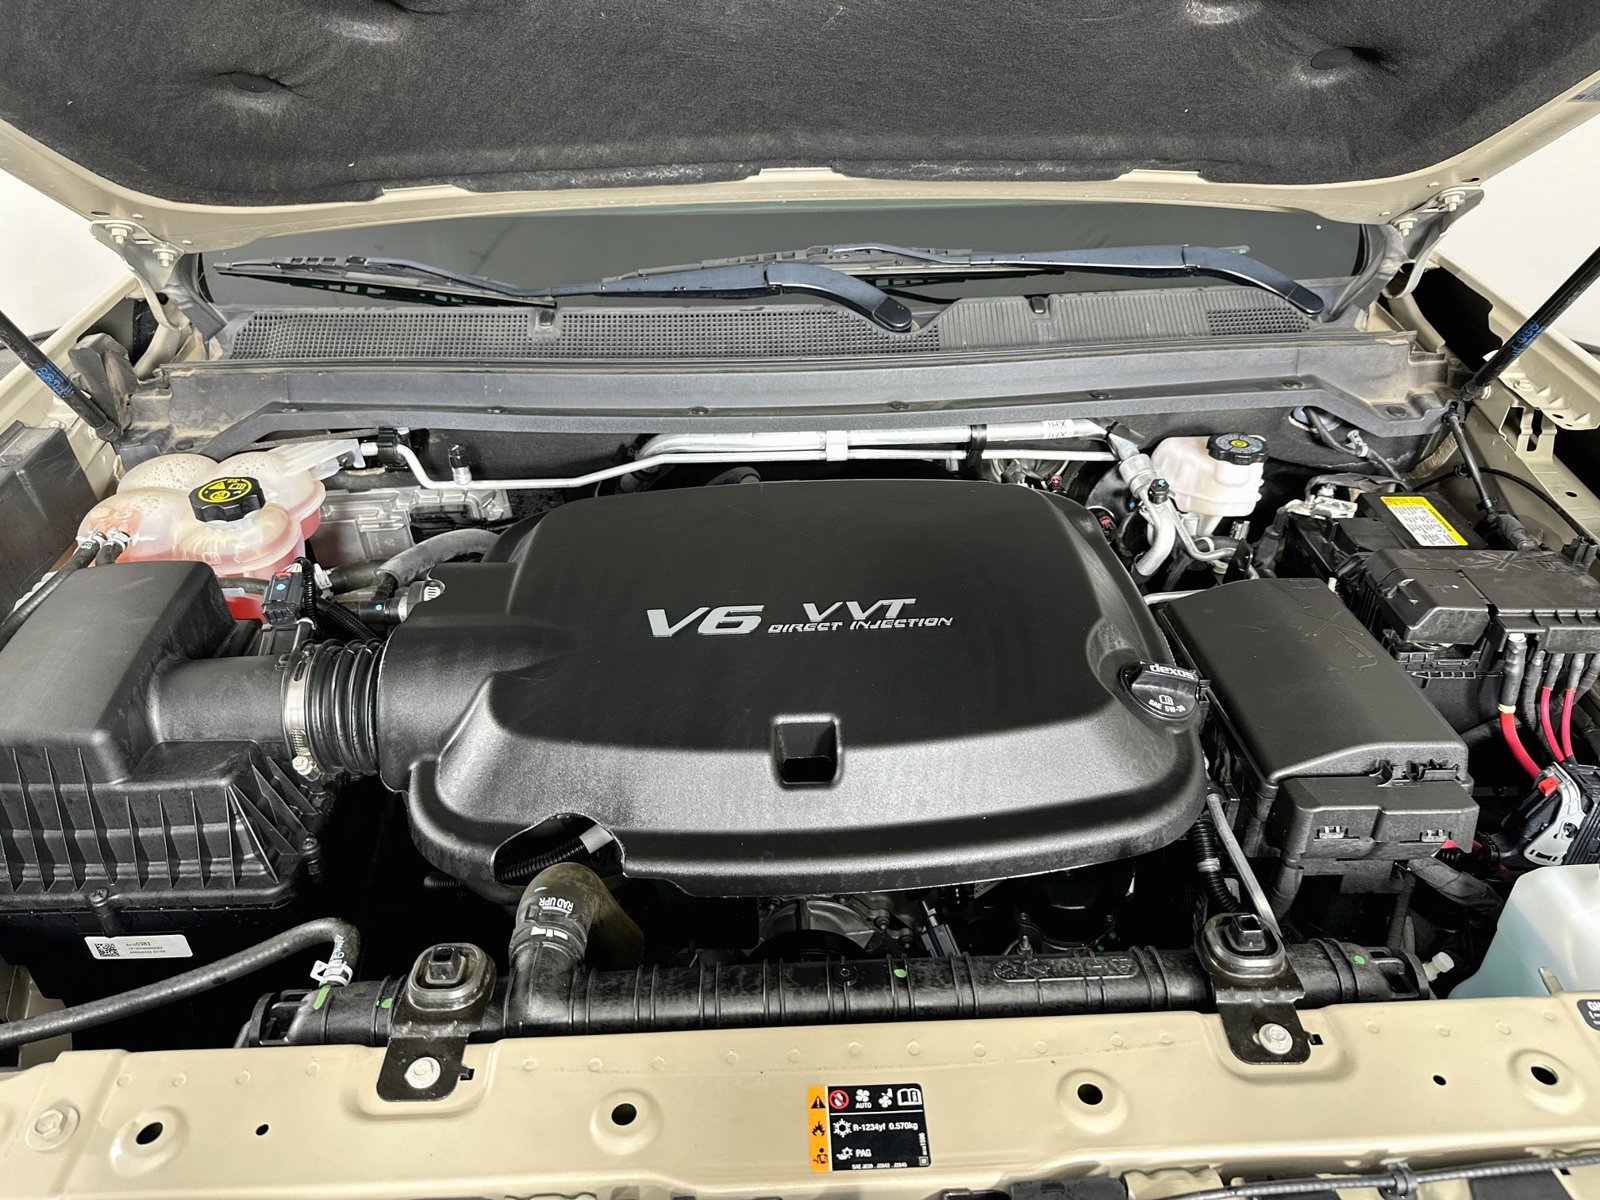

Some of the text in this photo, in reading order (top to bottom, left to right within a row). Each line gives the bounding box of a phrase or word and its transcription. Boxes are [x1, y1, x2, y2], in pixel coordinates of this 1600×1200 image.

[647, 598, 917, 637] V6 VVT
[768, 617, 954, 634] DIRECT INJECTION
[1149, 663, 1194, 679] dexos
[1148, 699, 1186, 713] SAE 5W-30
[539, 897, 573, 911] RAD UPR
[852, 1122, 918, 1132] R-1234yf 0.570kg
[855, 1148, 872, 1158] PAG
